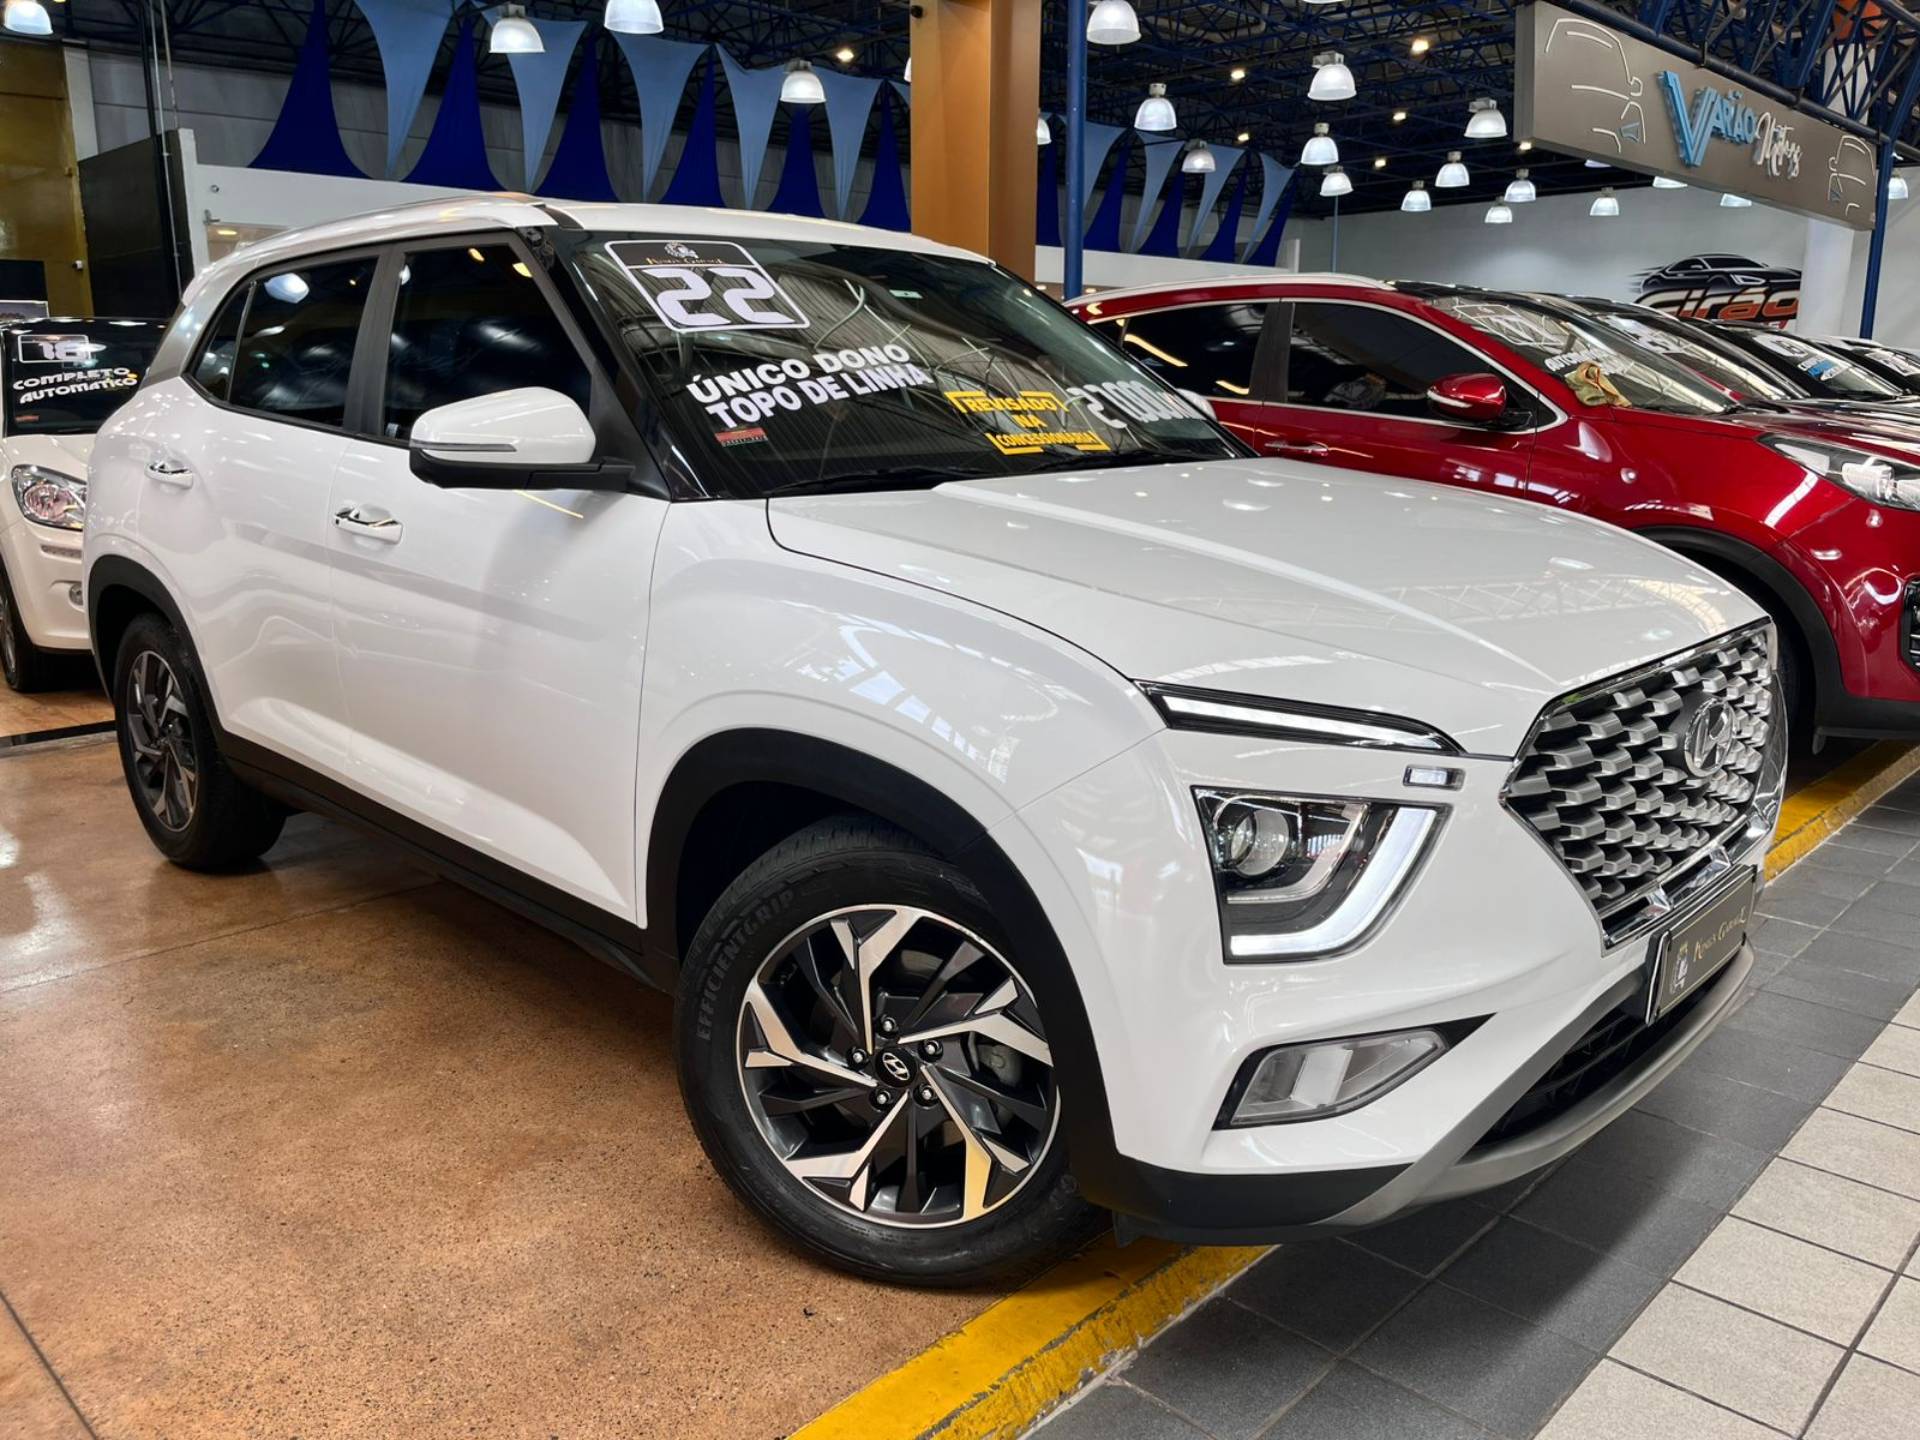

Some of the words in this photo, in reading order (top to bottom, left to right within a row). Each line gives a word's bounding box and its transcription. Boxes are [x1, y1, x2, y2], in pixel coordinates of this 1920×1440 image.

[641, 268, 796, 326] 22
[13, 367, 131, 390] COMPLETO
[686, 358, 811, 403] ÚNICO
[812, 344, 911, 373] DONO
[705, 386, 802, 428] TOPO
[797, 375, 850, 405] DE
[840, 363, 934, 396] LINHA
[964, 397, 1058, 411] REVISADO
[1011, 414, 1048, 428] NA
